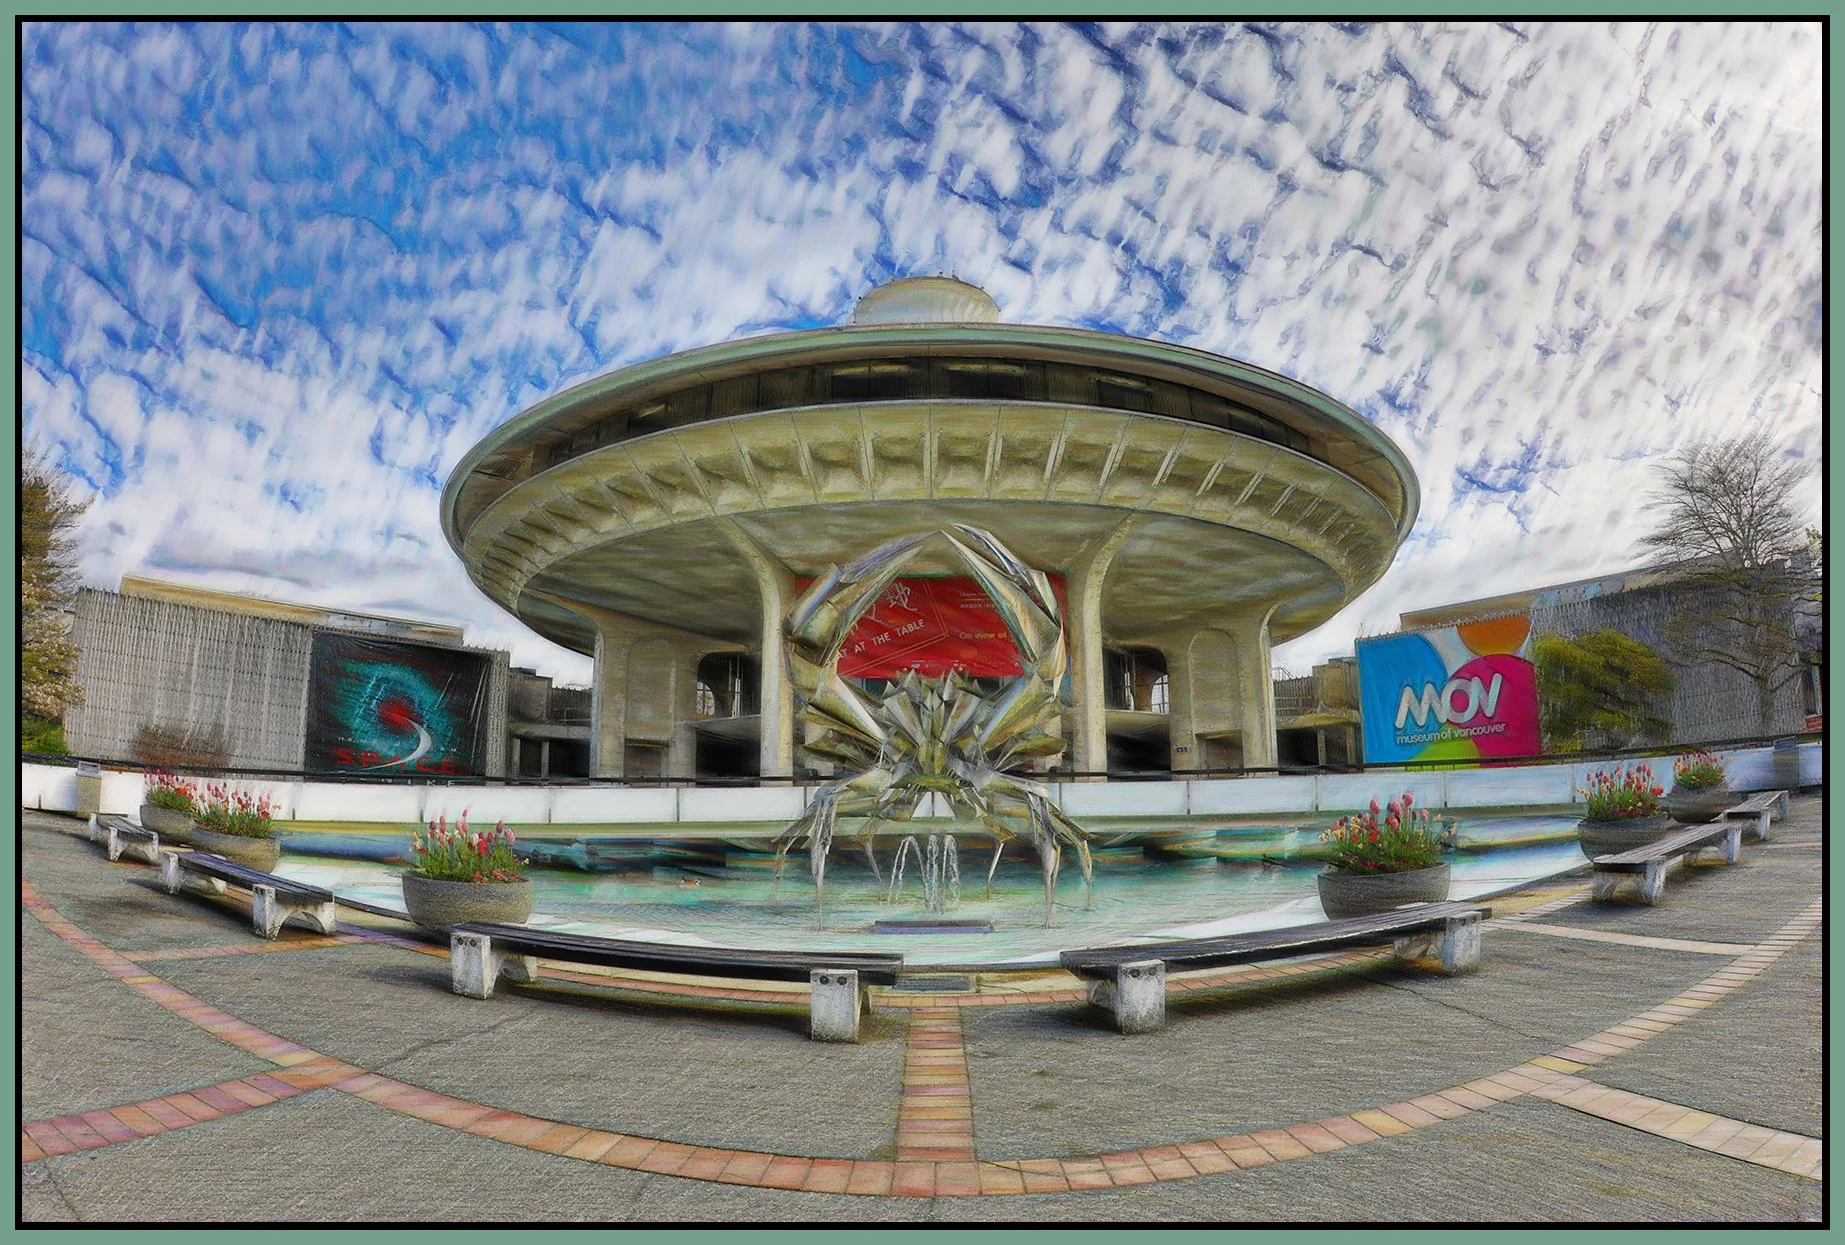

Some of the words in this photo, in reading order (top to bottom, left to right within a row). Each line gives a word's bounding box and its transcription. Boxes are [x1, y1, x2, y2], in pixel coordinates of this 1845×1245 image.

[854, 641, 866, 654] AT
[871, 632, 891, 647] THE
[895, 619, 926, 637] TABLE
[1395, 673, 1503, 728] MOV
[1397, 731, 1440, 745] museum
[1441, 728, 1453, 740] of
[1454, 723, 1506, 738] vancouver
[335, 747, 457, 775] SPACE
